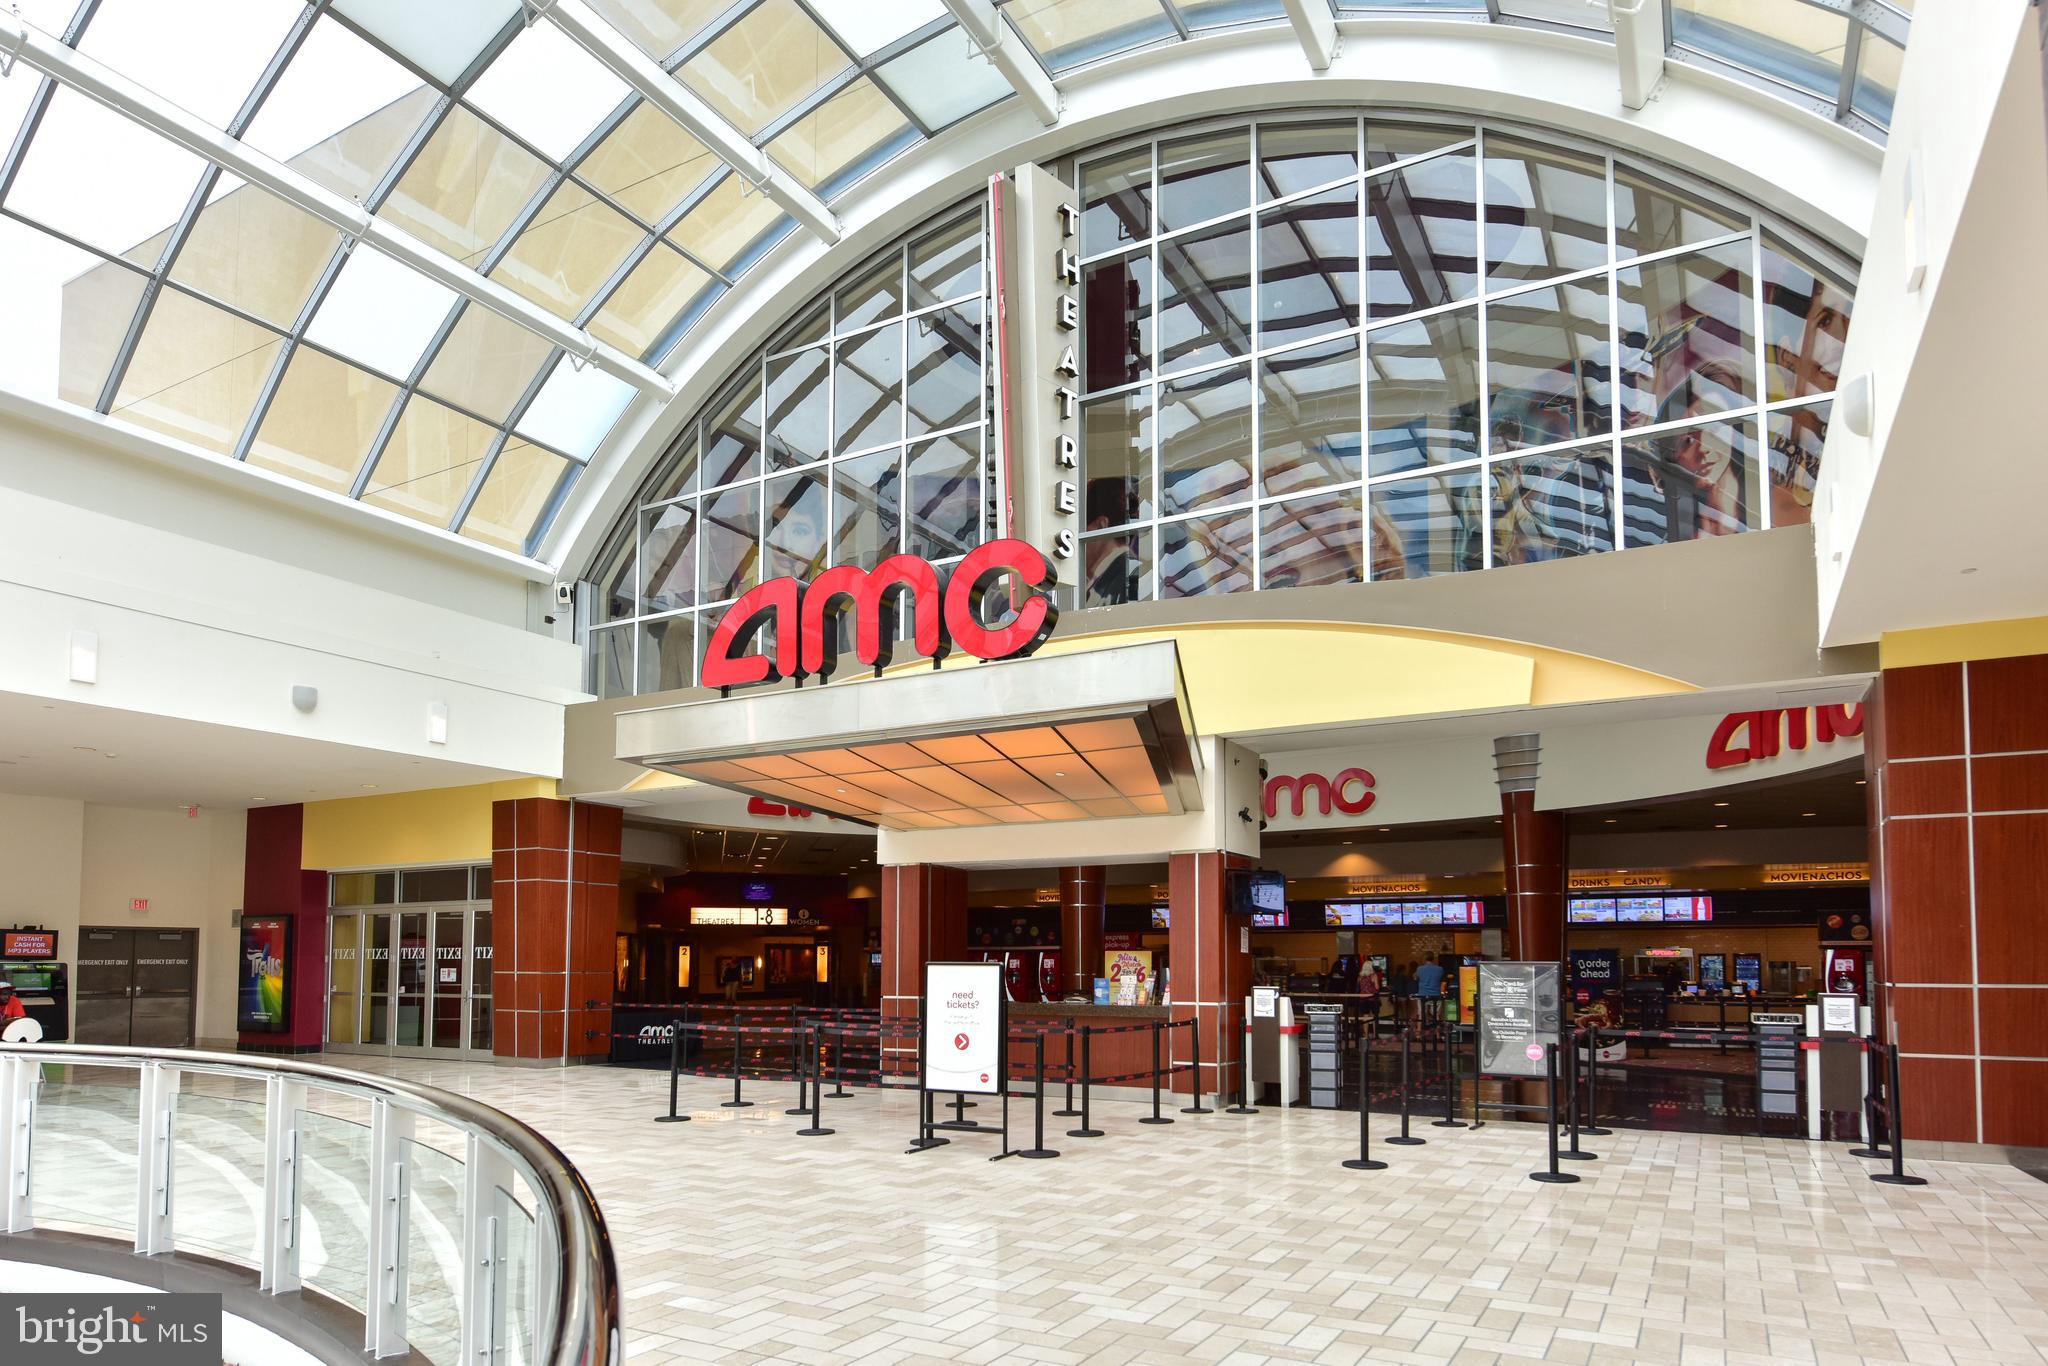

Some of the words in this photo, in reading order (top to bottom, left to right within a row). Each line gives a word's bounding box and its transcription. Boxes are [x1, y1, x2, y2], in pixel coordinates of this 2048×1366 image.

[1056, 201, 1080, 560] THEATRES
[701, 538, 1058, 690] amc
[1263, 767, 1376, 818] mc
[1770, 871, 1863, 882] MOVIENACHOS
[1571, 878, 1610, 887] DRINKS
[1623, 877, 1662, 886] CANDY
[1352, 883, 1421, 894] MOVIENACHOS
[1157, 891, 1169, 899] PO
[697, 917, 735, 926] THEATRES
[754, 908, 773, 925] 1-8
[789, 918, 819, 926] WOMEN
[1586, 958, 1611, 968] order
[1110, 963, 1121, 982] 2
[1580, 969, 1611, 979] ahead
[952, 990, 974, 999] need
[946, 1000, 980, 1009] tickets?
